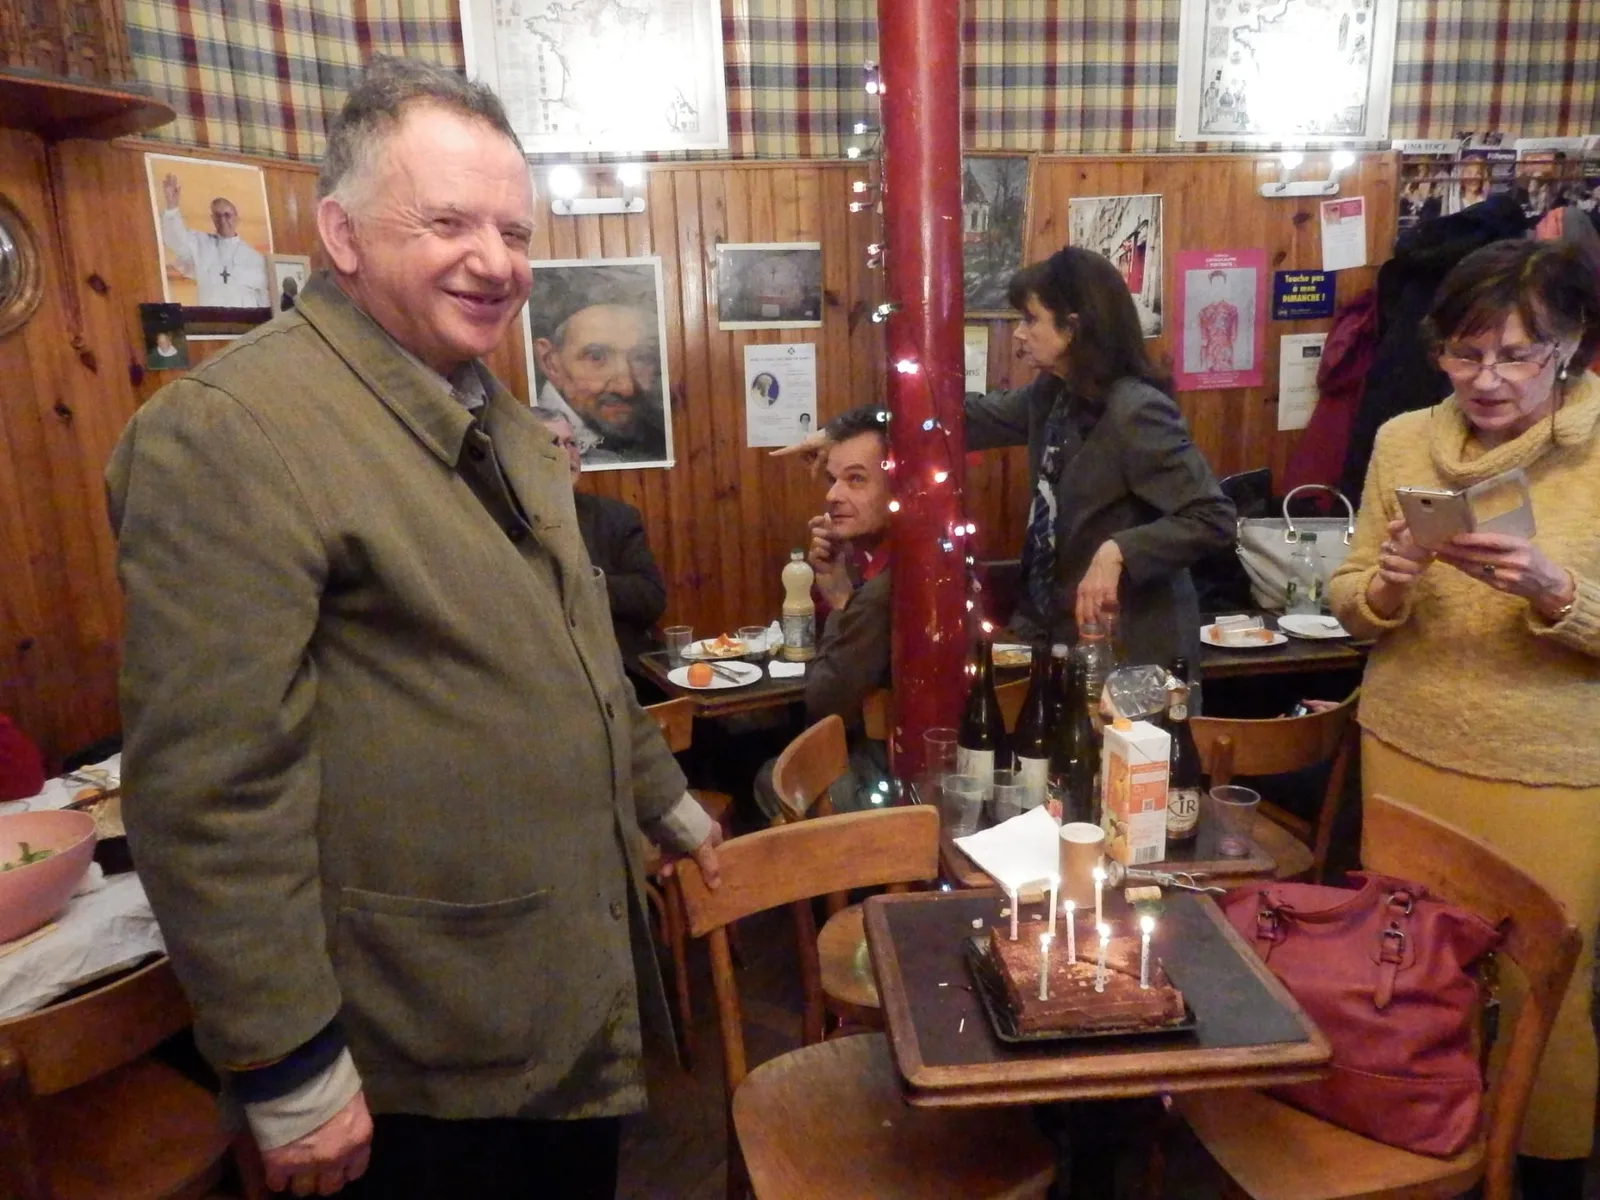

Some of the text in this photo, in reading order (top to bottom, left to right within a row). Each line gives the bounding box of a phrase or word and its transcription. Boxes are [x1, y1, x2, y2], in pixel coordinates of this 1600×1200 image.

[1284, 274, 1325, 284] Touche pas
[1282, 293, 1320, 303] DIMANCHE
